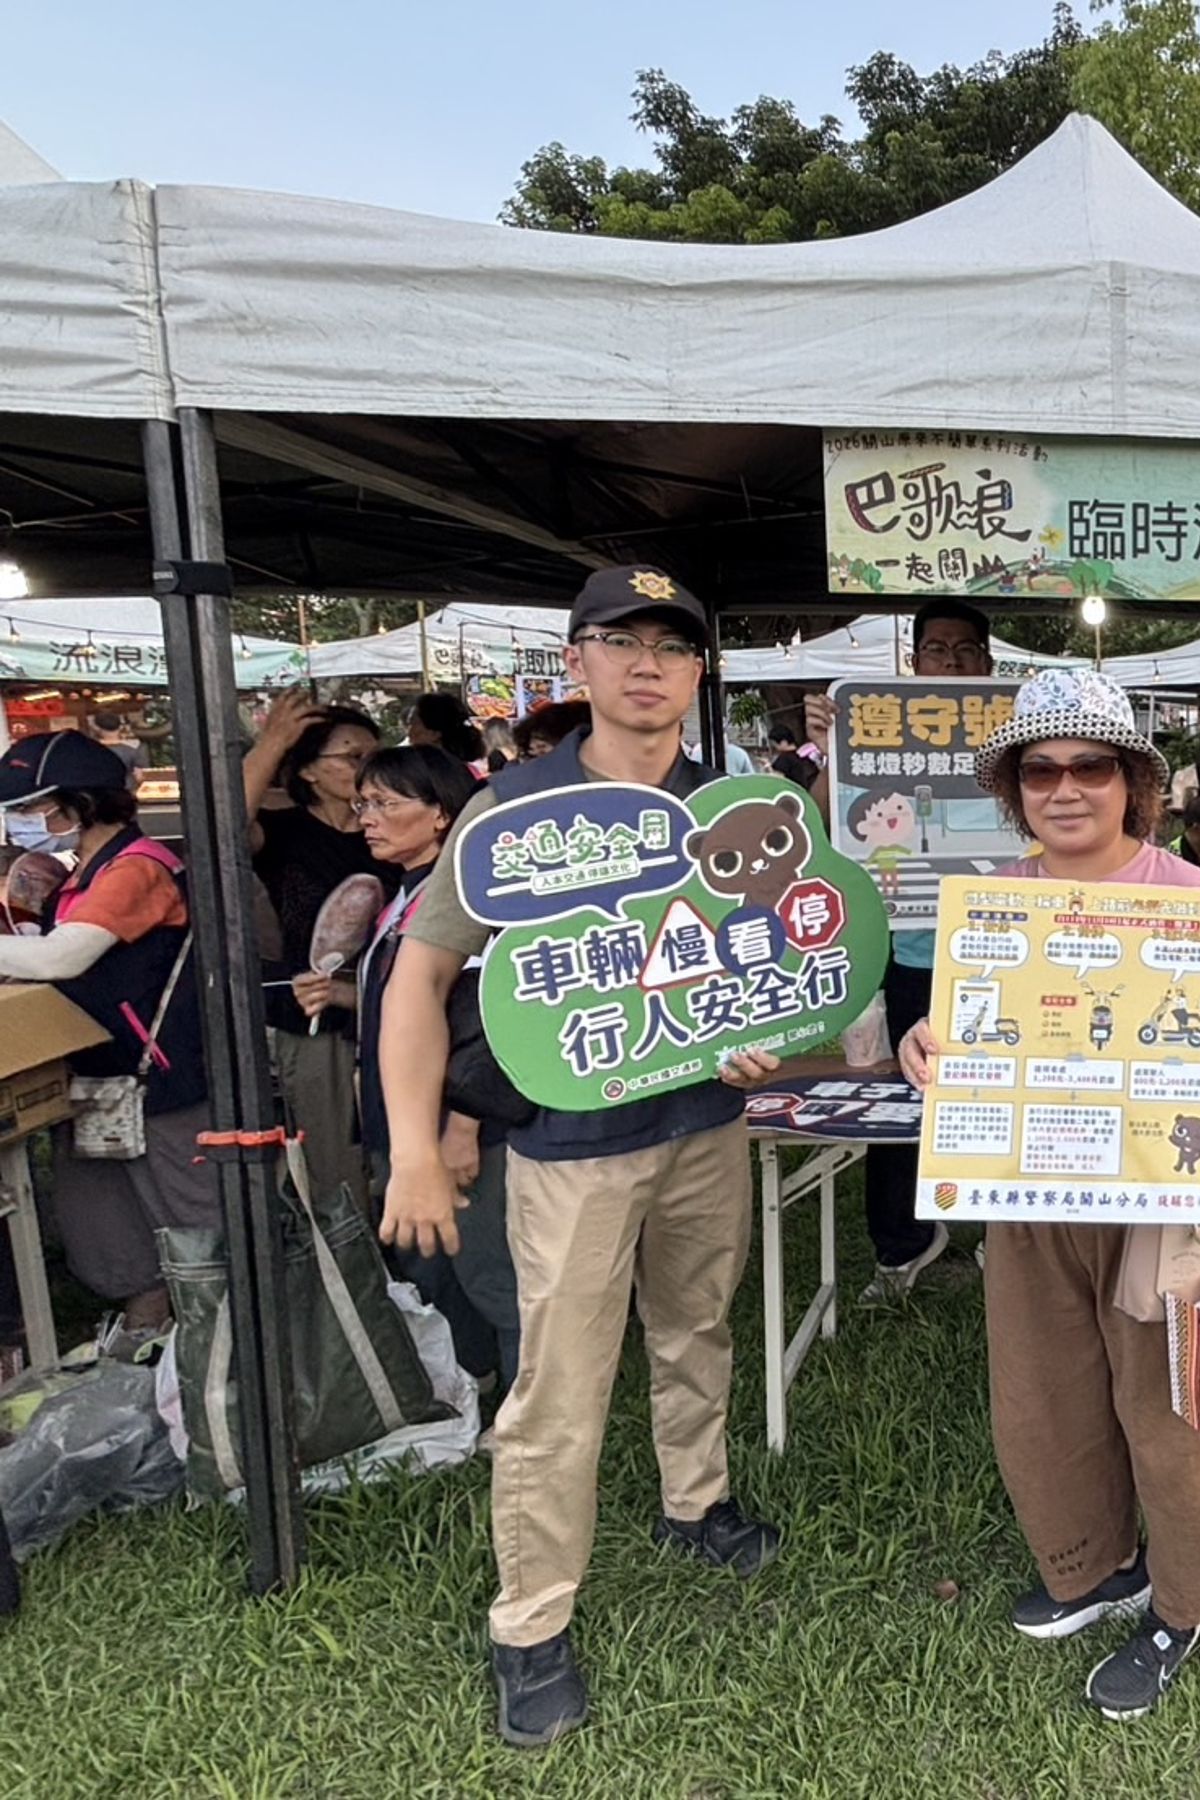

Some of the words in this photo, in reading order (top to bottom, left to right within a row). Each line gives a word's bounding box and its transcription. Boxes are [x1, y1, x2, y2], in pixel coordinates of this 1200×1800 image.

[492, 810, 670, 877] 交通安全月
[562, 948, 850, 1078] 行人安全行
[968, 1188, 1148, 1208] 臺東縣警察局關山分局
